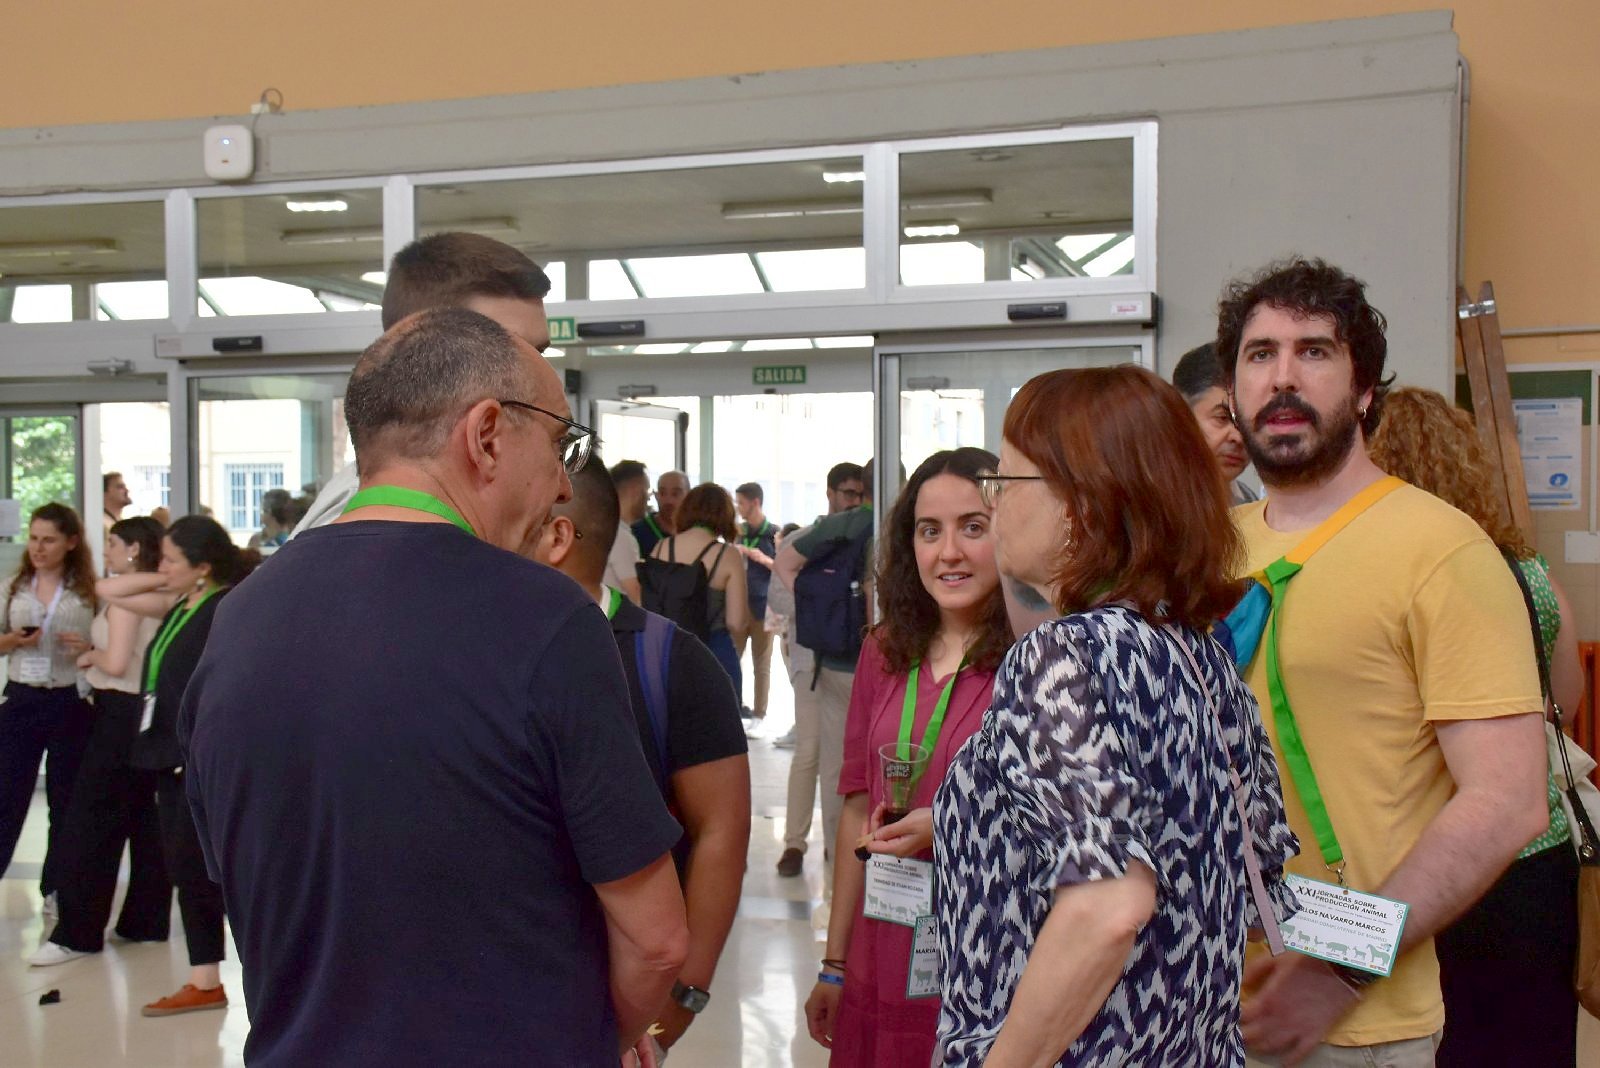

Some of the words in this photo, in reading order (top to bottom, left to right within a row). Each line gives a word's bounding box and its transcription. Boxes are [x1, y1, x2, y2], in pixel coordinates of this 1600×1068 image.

[756, 368, 803, 382] SALIDA
[1296, 886, 1316, 898] XXI
[1317, 890, 1352, 903] JORNADAS
[1354, 899, 1377, 910] SOBRE
[1316, 895, 1360, 911] PRODUCCIÓN
[1361, 907, 1388, 919] ANIMAL
[1319, 911, 1354, 925] NAVARRO
[1355, 921, 1387, 934] MARCOS
